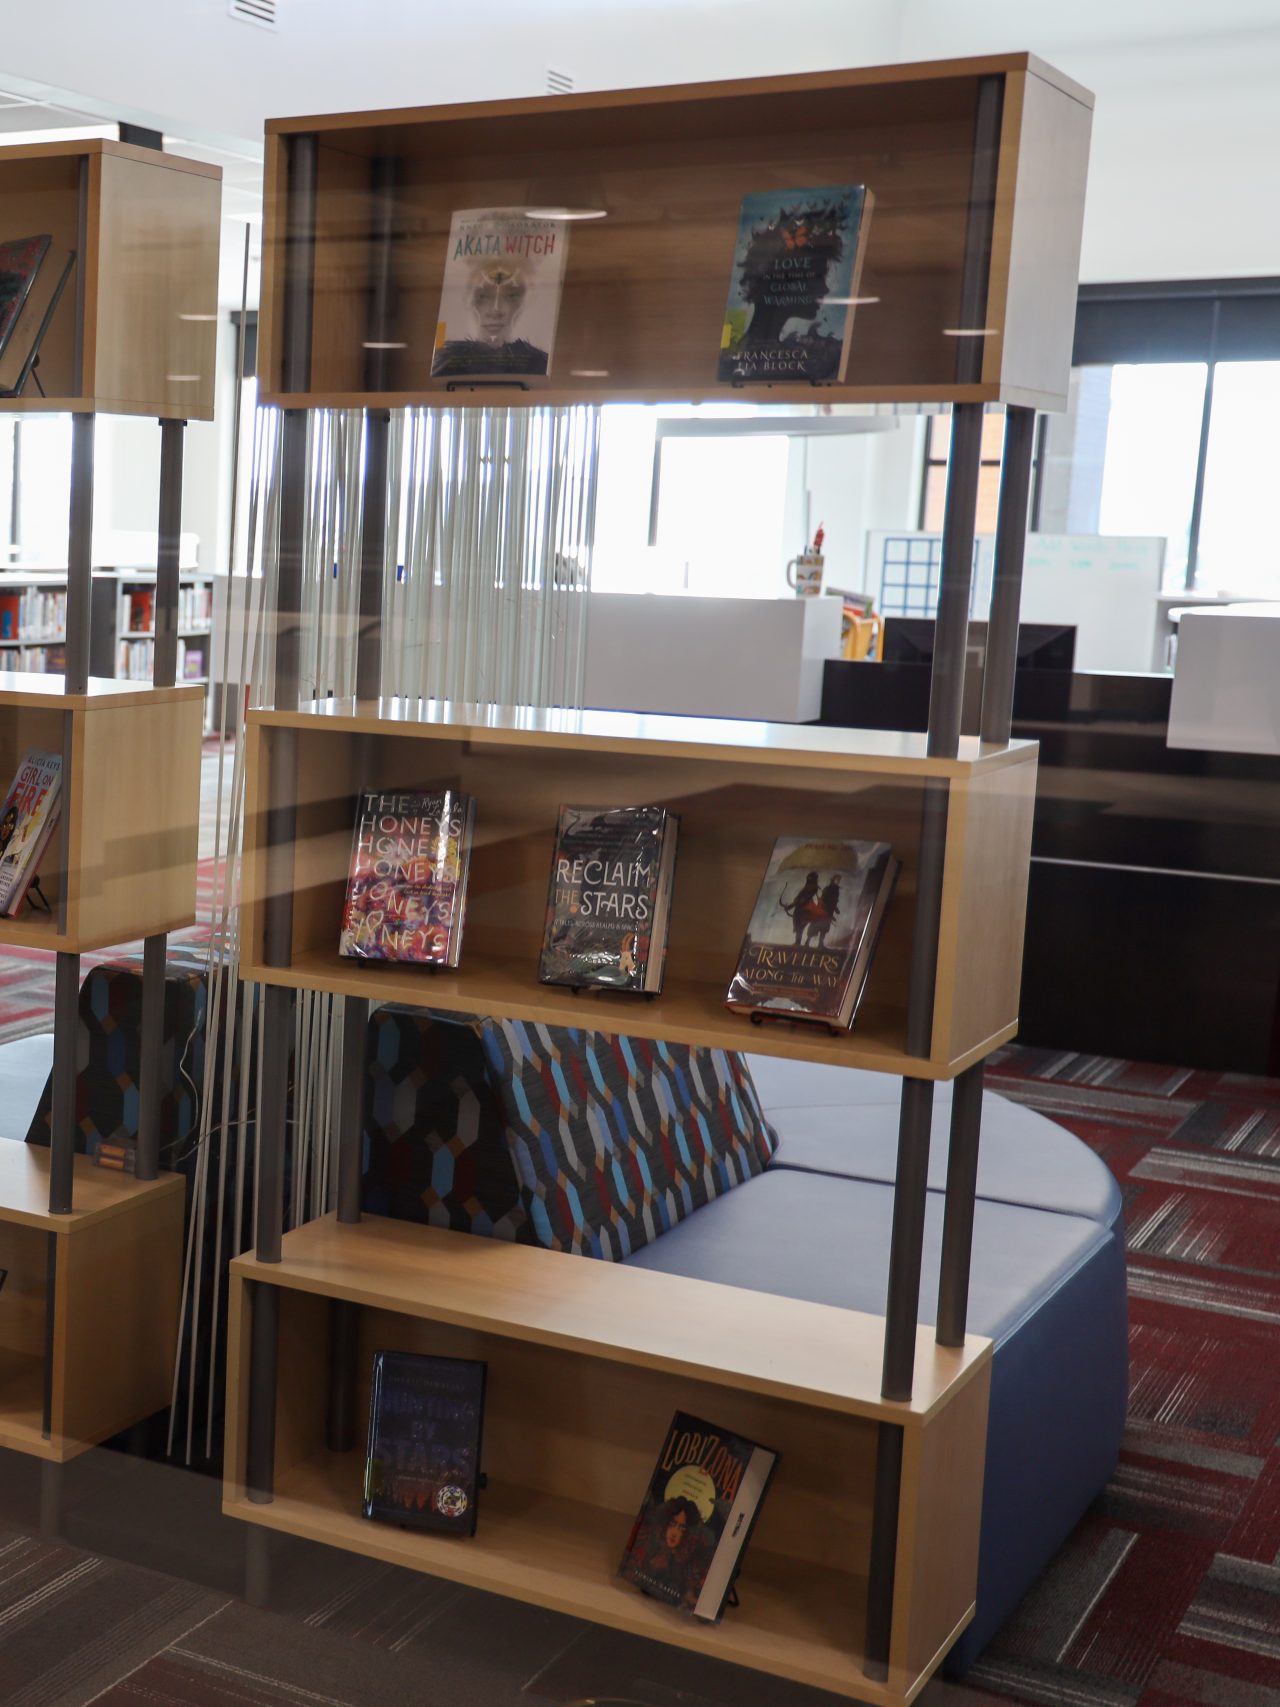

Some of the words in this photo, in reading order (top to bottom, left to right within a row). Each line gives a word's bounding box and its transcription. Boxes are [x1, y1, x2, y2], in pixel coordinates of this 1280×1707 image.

[453, 234, 500, 261] AKATA
[505, 233, 556, 258] WITCH
[774, 256, 812, 271] LOVE
[770, 281, 809, 293] GLOBAL
[762, 294, 813, 306] WARMING
[737, 349, 808, 362] FRANCESCA
[737, 361, 757, 371] LIA
[763, 360, 808, 372] BLOCK
[45, 760, 61, 771] KEYS
[20, 766, 43, 787] GIRL
[42, 775, 54, 787] ON
[7, 782, 48, 816] FIRE
[364, 794, 410, 814] THE
[361, 814, 462, 837] HONEYS
[556, 858, 652, 889] RECLAIM
[555, 887, 578, 906] THE
[580, 890, 649, 920] STARS
[749, 945, 840, 973] TRAVELERS
[744, 968, 784, 982] ALONG
[790, 971, 804, 984] THE
[812, 974, 839, 988] WAY
[661, 1430, 745, 1500] LOBIZONA
